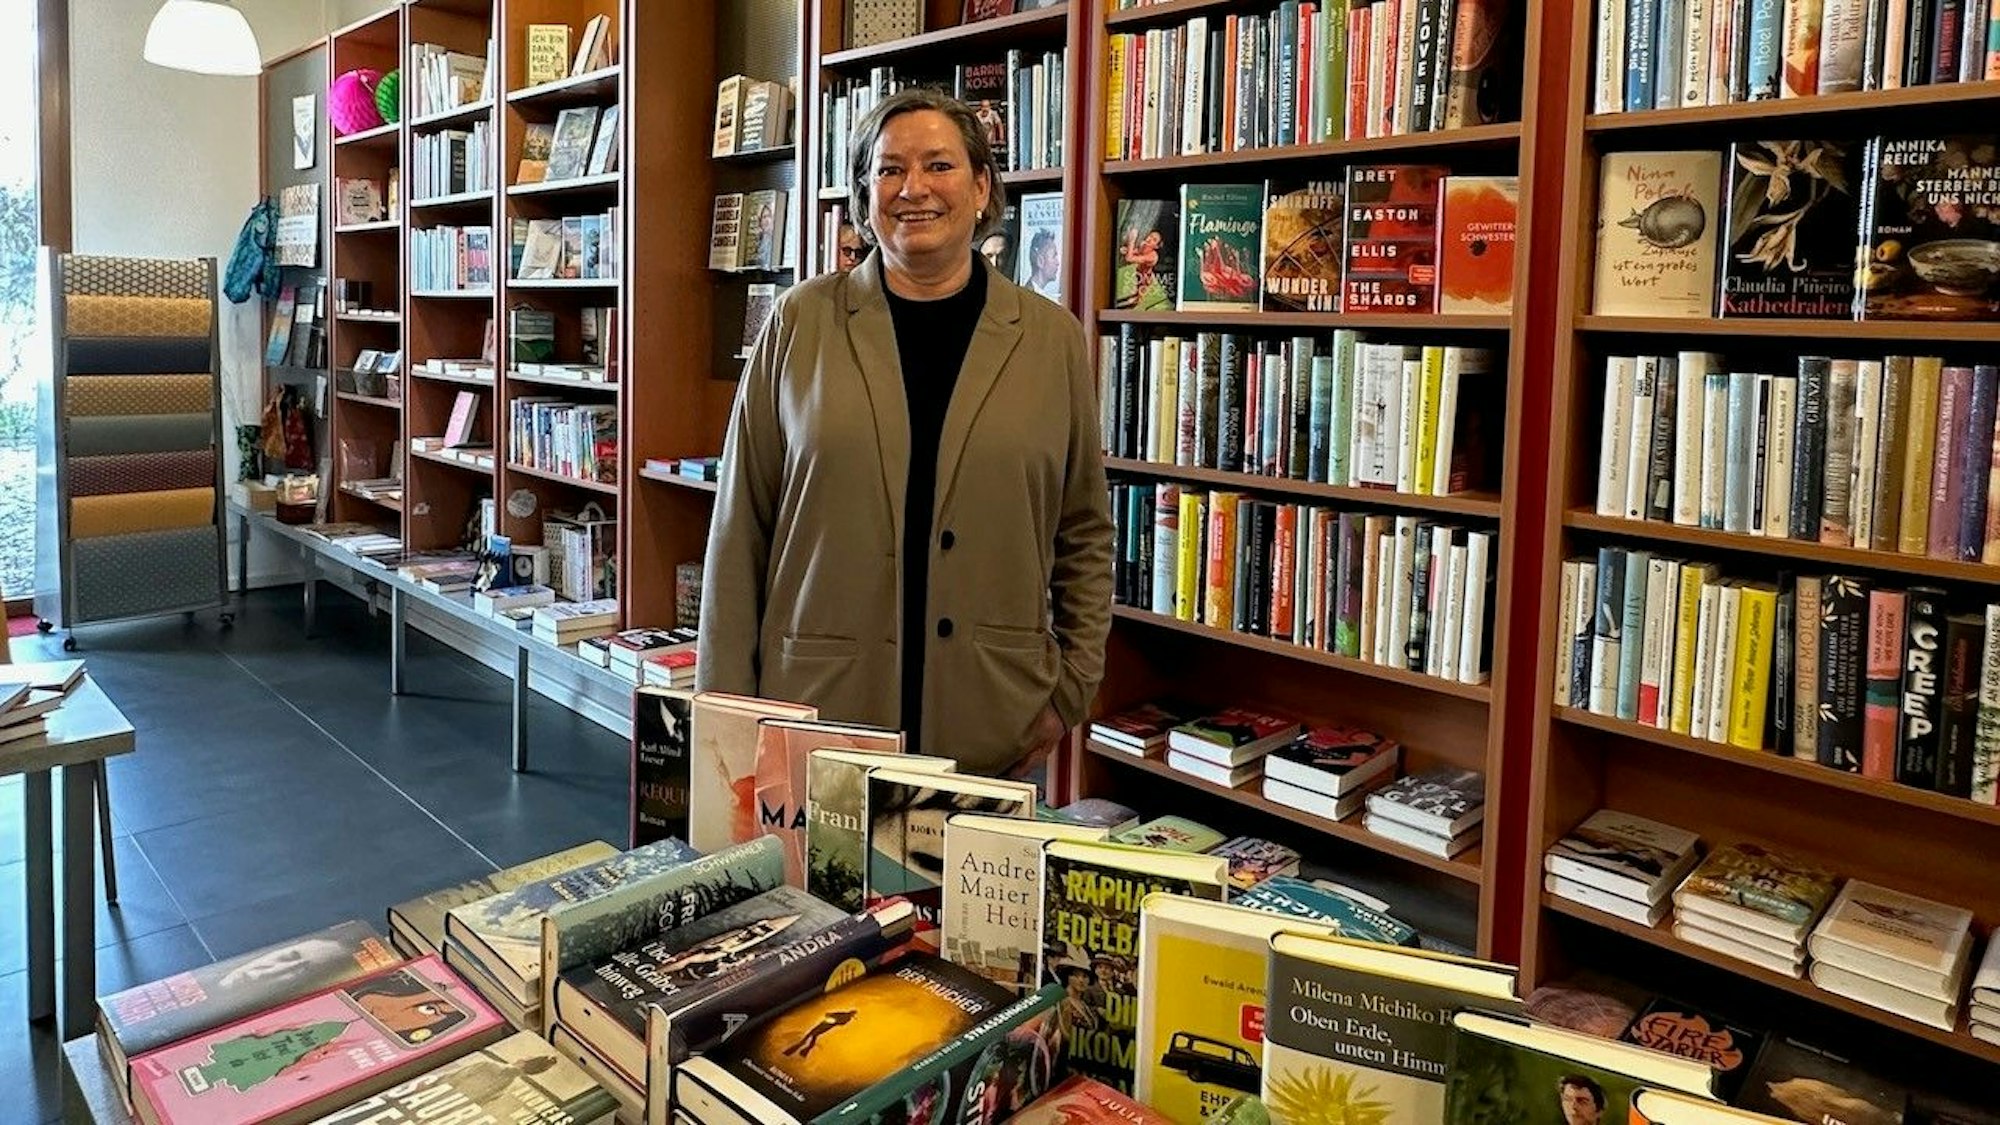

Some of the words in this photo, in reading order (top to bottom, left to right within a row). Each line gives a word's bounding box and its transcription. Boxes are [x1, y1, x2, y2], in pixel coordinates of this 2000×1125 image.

[1885, 140, 1947, 153] ANNIKA
[1883, 152, 1930, 165] REICH
[1354, 170, 1397, 182] BRET
[1626, 164, 1675, 182] Nina
[1308, 181, 1345, 196] KARIN
[1915, 179, 1983, 192] STERBEN
[1928, 192, 1960, 205] UNS
[1189, 213, 1258, 237] Flamingo
[1352, 208, 1419, 221] EASTON
[1877, 225, 1912, 234] ROMAN
[1350, 245, 1397, 257] ELLIS
[1266, 277, 1328, 295] WUNDER
[1349, 282, 1381, 294] THE
[1621, 275, 1661, 288] Wort
[1725, 275, 1786, 293] Claudia
[1792, 276, 1850, 294] Piñeiro
[1349, 294, 1417, 306] SHARDS
[1724, 293, 1850, 315] Kathedralen
[1805, 373, 1822, 424] GRENZE
[1799, 590, 1815, 661] MOLCHE
[1828, 632, 1838, 676] WILLIAMS
[1797, 666, 1814, 692] DIE
[1903, 618, 1938, 739] CREEP
[691, 842, 765, 875] SCHWIMMER
[960, 852, 1037, 882] Andre
[960, 874, 1030, 905] Maier
[778, 931, 842, 966] ANDRA
[895, 967, 927, 990] DER
[924, 977, 983, 1016] TAUCHER
[1203, 975, 1235, 991] Ewald
[1292, 977, 1353, 1008] Milena
[1360, 992, 1434, 1024] Michiko
[1289, 1005, 1340, 1034] Oben
[1344, 1017, 1394, 1048] Erde,
[1649, 1016, 1728, 1050] FIRE
[1335, 1040, 1387, 1064] unten
[1641, 1029, 1727, 1069] STARTER
[1100, 1098, 1144, 1125] JULIA
